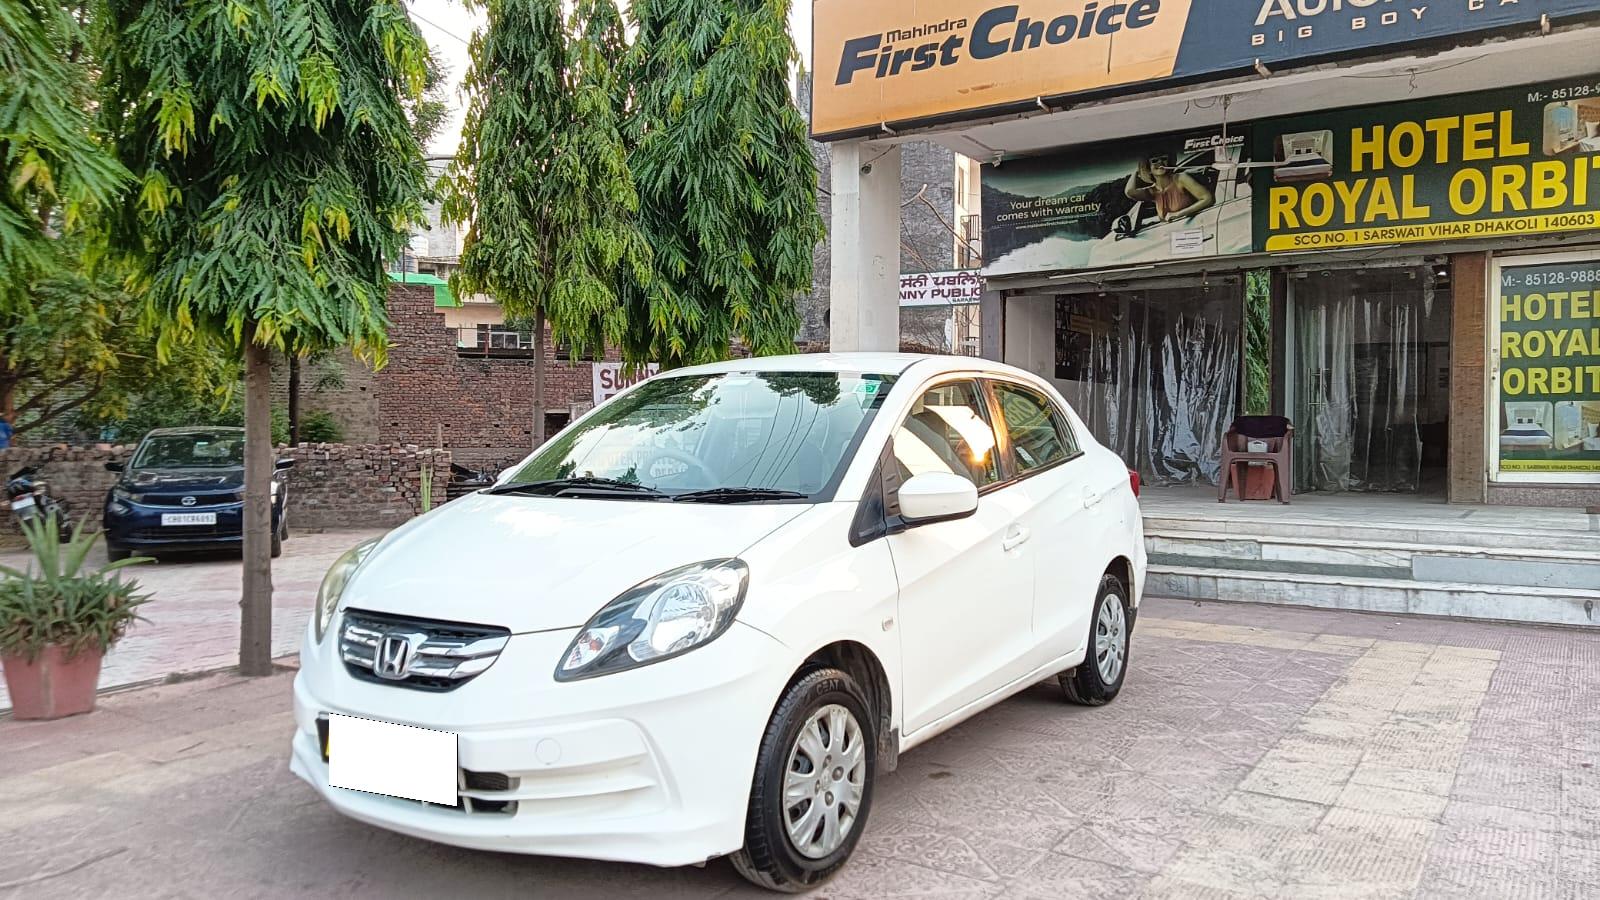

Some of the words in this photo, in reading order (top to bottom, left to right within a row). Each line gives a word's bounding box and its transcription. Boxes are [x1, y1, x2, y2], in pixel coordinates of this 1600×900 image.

[886, 18, 968, 44] Mahindra
[1251, 26, 1313, 46] BIG
[1351, 7, 1428, 30] BOY
[835, 33, 964, 86] First
[968, 0, 1161, 60] Choice
[1184, 139, 1210, 150] First
[1351, 109, 1530, 172] HOTEL
[1009, 200, 1033, 210] Your
[1034, 196, 1068, 207] dream
[1070, 194, 1086, 203] car
[1269, 174, 1430, 230] ROYAL
[1449, 155, 1600, 216] ORBI
[996, 211, 1029, 222] comes
[1030, 207, 1053, 218] with
[1055, 202, 1101, 214] warranty
[1294, 233, 1321, 246] SCO
[1325, 232, 1349, 244] NO.
[1354, 231, 1359, 241] 1
[1363, 227, 1425, 241] SARSWATI
[1429, 223, 1470, 236] VIHAR
[1474, 218, 1538, 233] DHAKOLI
[1544, 213, 1595, 228] 140603
[1502, 365, 1600, 395] ORBIT
